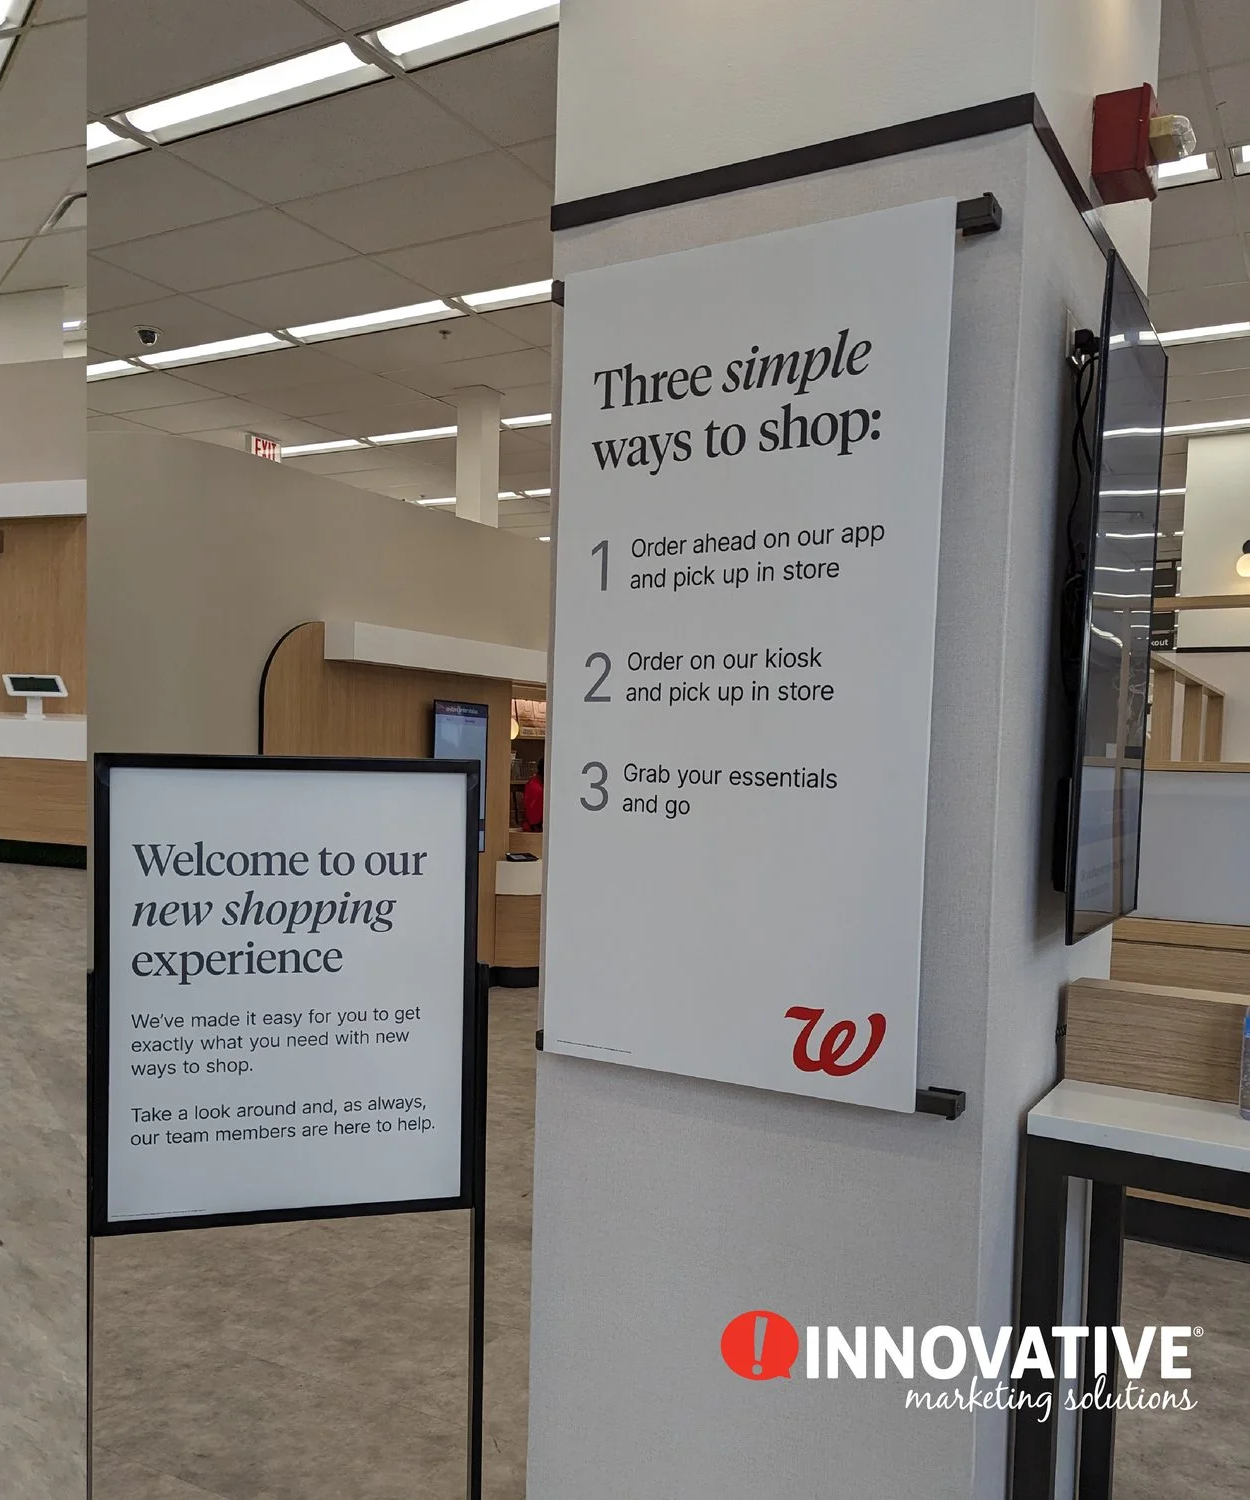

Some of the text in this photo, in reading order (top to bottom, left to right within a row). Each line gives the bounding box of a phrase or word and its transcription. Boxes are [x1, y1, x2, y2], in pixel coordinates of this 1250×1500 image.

[594, 328, 872, 410] Three simple
[255, 438, 276, 460] EXIT
[591, 403, 881, 476] ways to shop:
[592, 525, 885, 591] 1 Order ahead on our app
[630, 561, 839, 592] and pick up in store
[584, 647, 822, 702] 2 Order on our kiosk
[626, 681, 834, 706] and pick up in store
[580, 762, 837, 811] 3 Grab your essentials
[623, 795, 690, 819] and go
[132, 841, 427, 876] Welcome to our
[132, 890, 397, 934] new shopping
[132, 941, 342, 985] experience
[192, 1012, 240, 1027] made
[247, 1011, 256, 1025] it
[263, 1013, 302, 1027] easy
[308, 1009, 331, 1023] for
[338, 1011, 367, 1026] you
[373, 1008, 388, 1021] to
[395, 1007, 420, 1024] get
[131, 1030, 409, 1054] exactly what you need with new
[131, 1058, 252, 1079] ways to shop.
[131, 1096, 426, 1122] Take a look around and, as always,
[131, 1116, 434, 1145] our team members are here to help.
